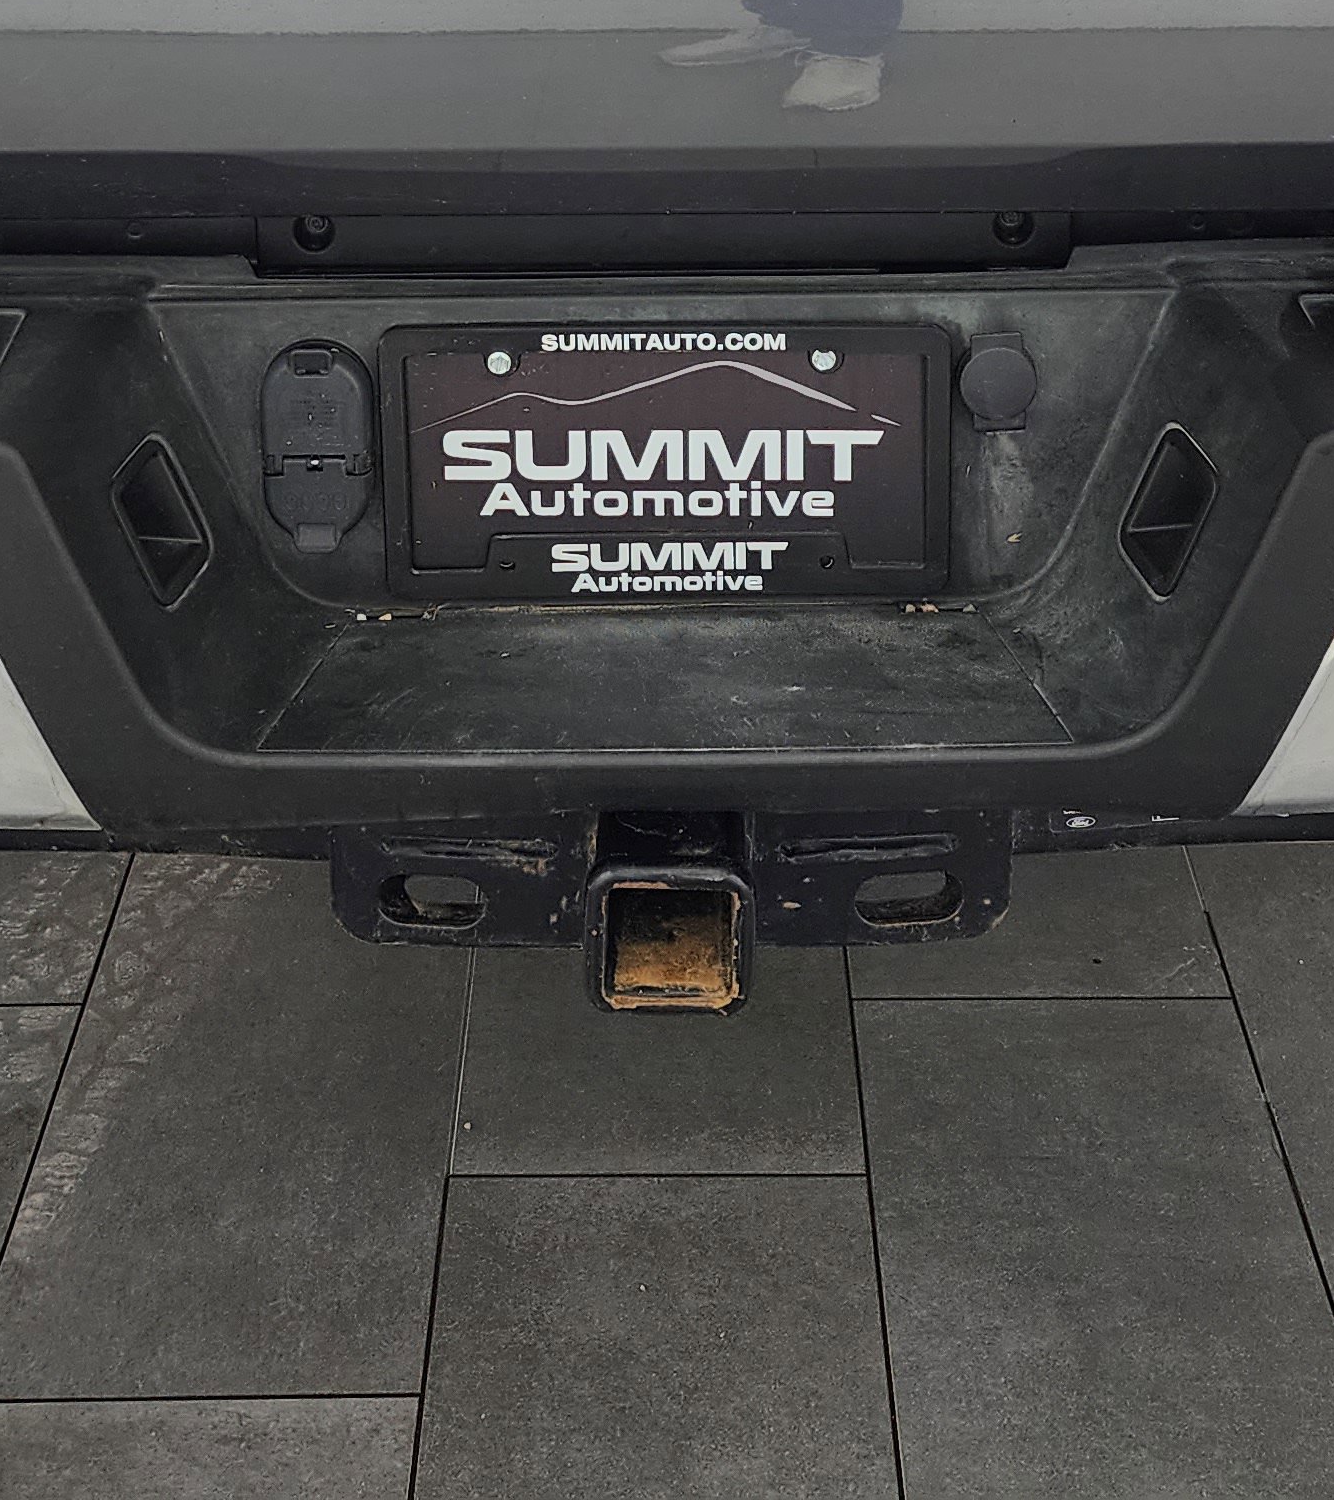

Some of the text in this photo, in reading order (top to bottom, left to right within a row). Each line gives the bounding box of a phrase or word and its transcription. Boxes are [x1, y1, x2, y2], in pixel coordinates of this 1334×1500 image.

[540, 332, 787, 352] SUMMITAUTO.COM
[442, 429, 885, 482] SUMMIT
[480, 481, 835, 518] Automotive
[551, 541, 790, 572] SUMMIT
[570, 572, 764, 593] Automotive
